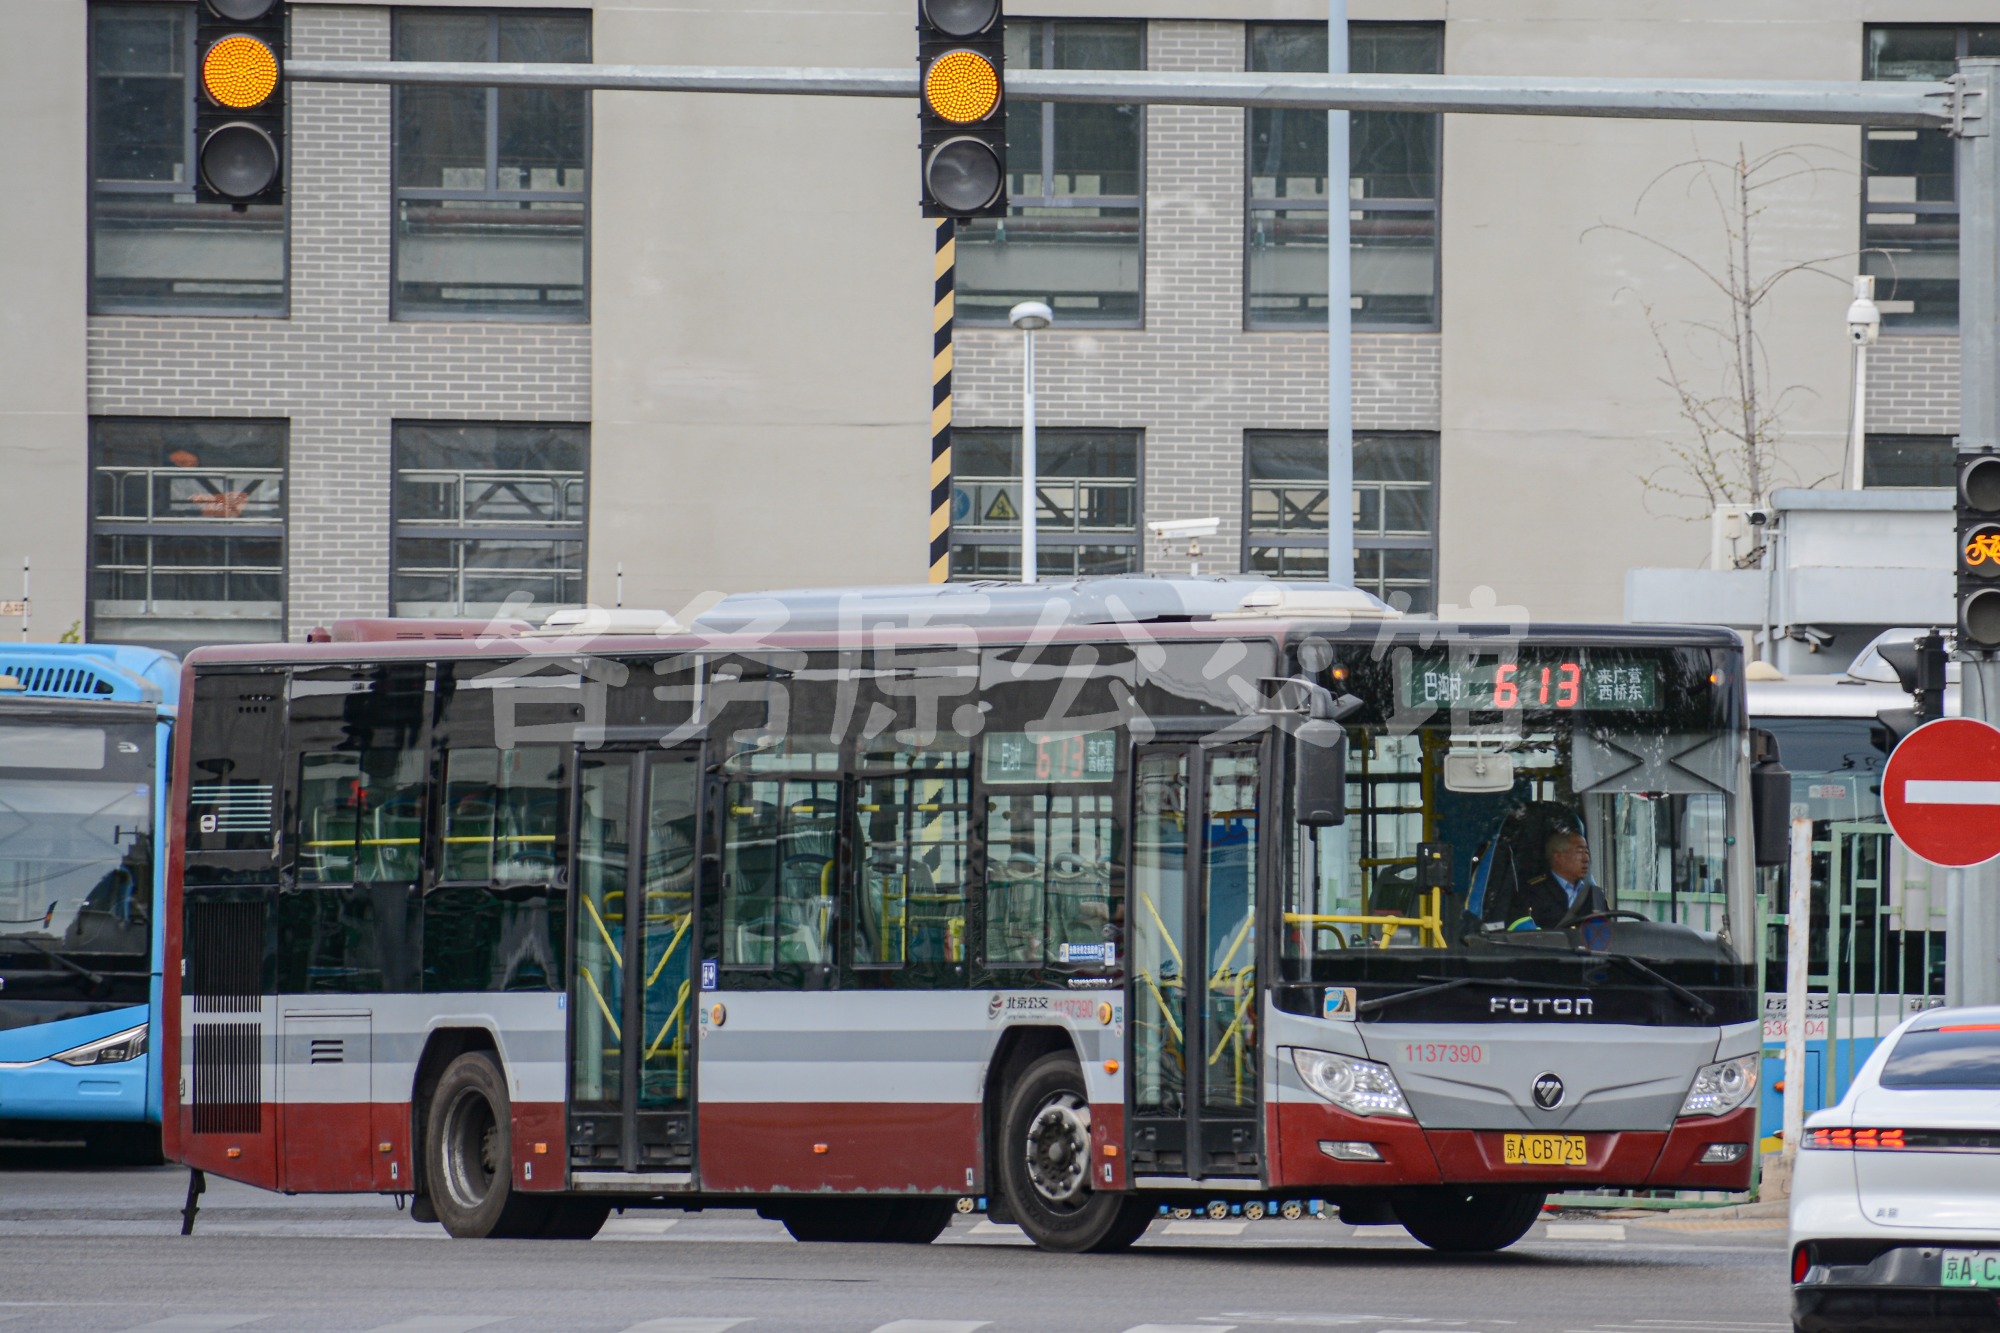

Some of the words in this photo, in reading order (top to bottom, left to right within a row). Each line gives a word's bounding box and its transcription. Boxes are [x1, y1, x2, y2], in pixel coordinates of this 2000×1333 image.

[1598, 668, 1643, 684] 来广营
[1424, 671, 1462, 701] 巴沟村
[1494, 663, 1581, 708] 613
[1599, 684, 1643, 701] 西桥东
[1036, 735, 1085, 779] 613
[1006, 997, 1048, 1009] 北京公交
[1053, 1000, 1093, 1018] 1137390
[1490, 997, 1593, 1015] FOTON
[1405, 1043, 1482, 1063] 1137390
